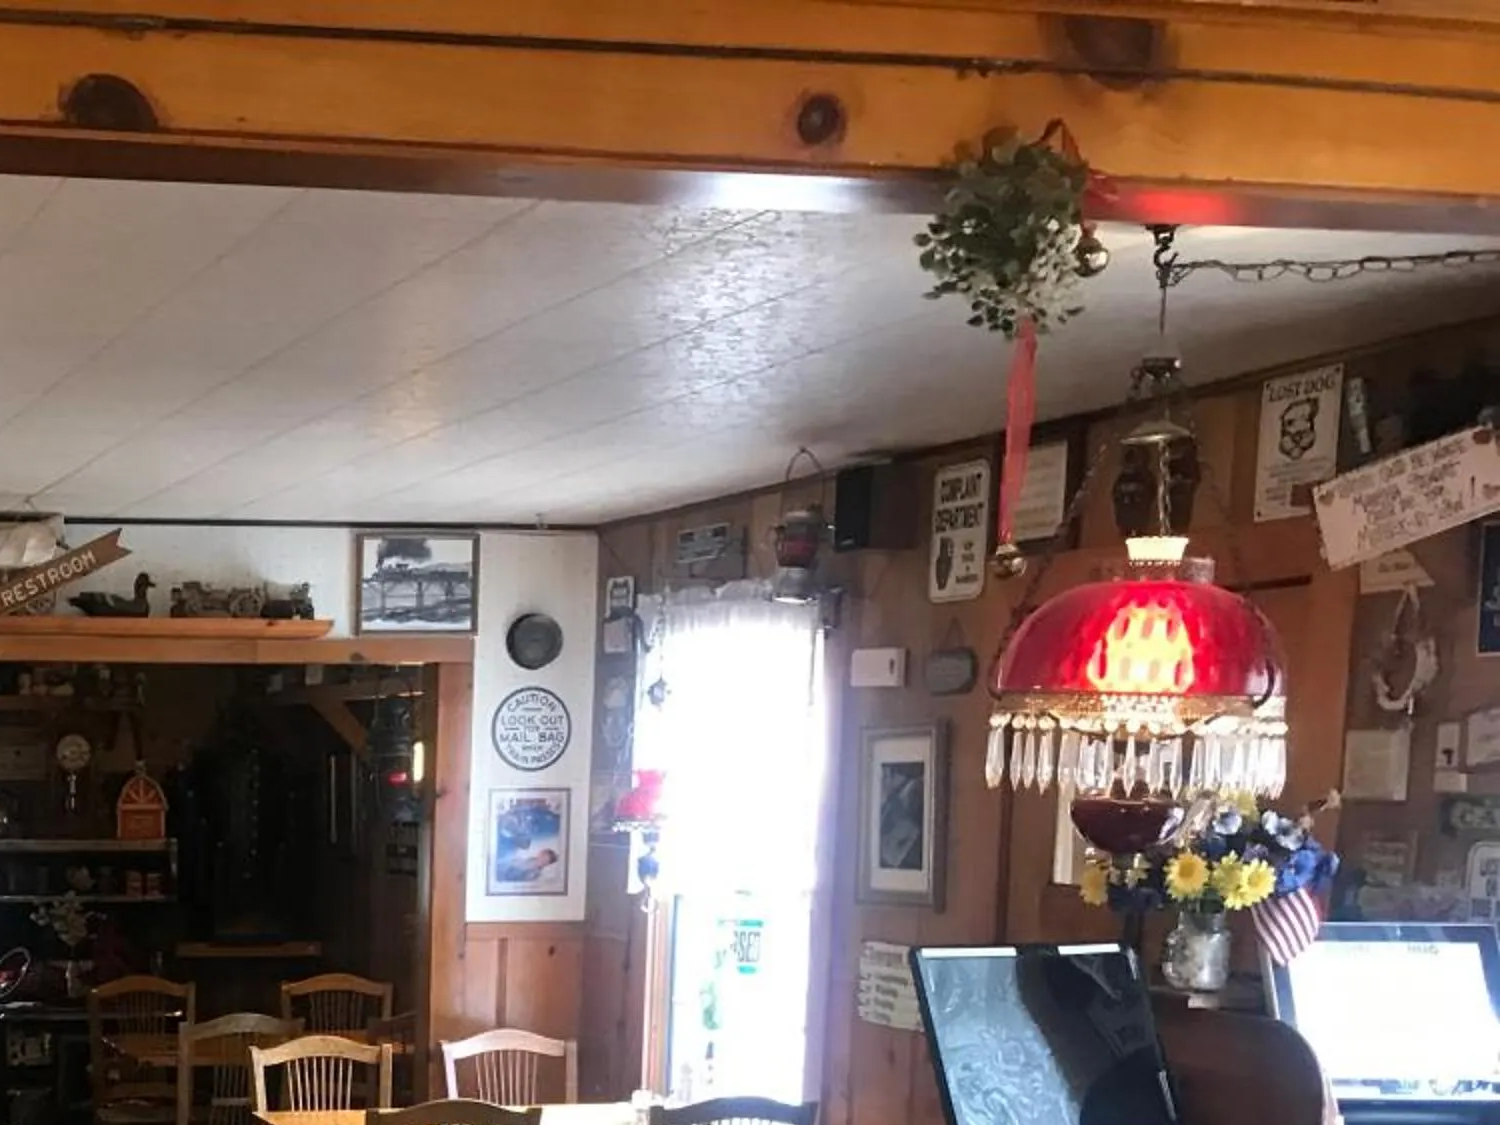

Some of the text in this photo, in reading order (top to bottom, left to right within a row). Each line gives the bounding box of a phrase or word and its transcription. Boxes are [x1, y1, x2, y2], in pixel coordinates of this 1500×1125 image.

[1304, 374, 1336, 395] DOG
[1, 549, 97, 607] RESTROOM
[507, 693, 557, 712] CAUTION
[501, 715, 564, 725] LOOK OUT
[500, 732, 564, 742] MAIL BAG
